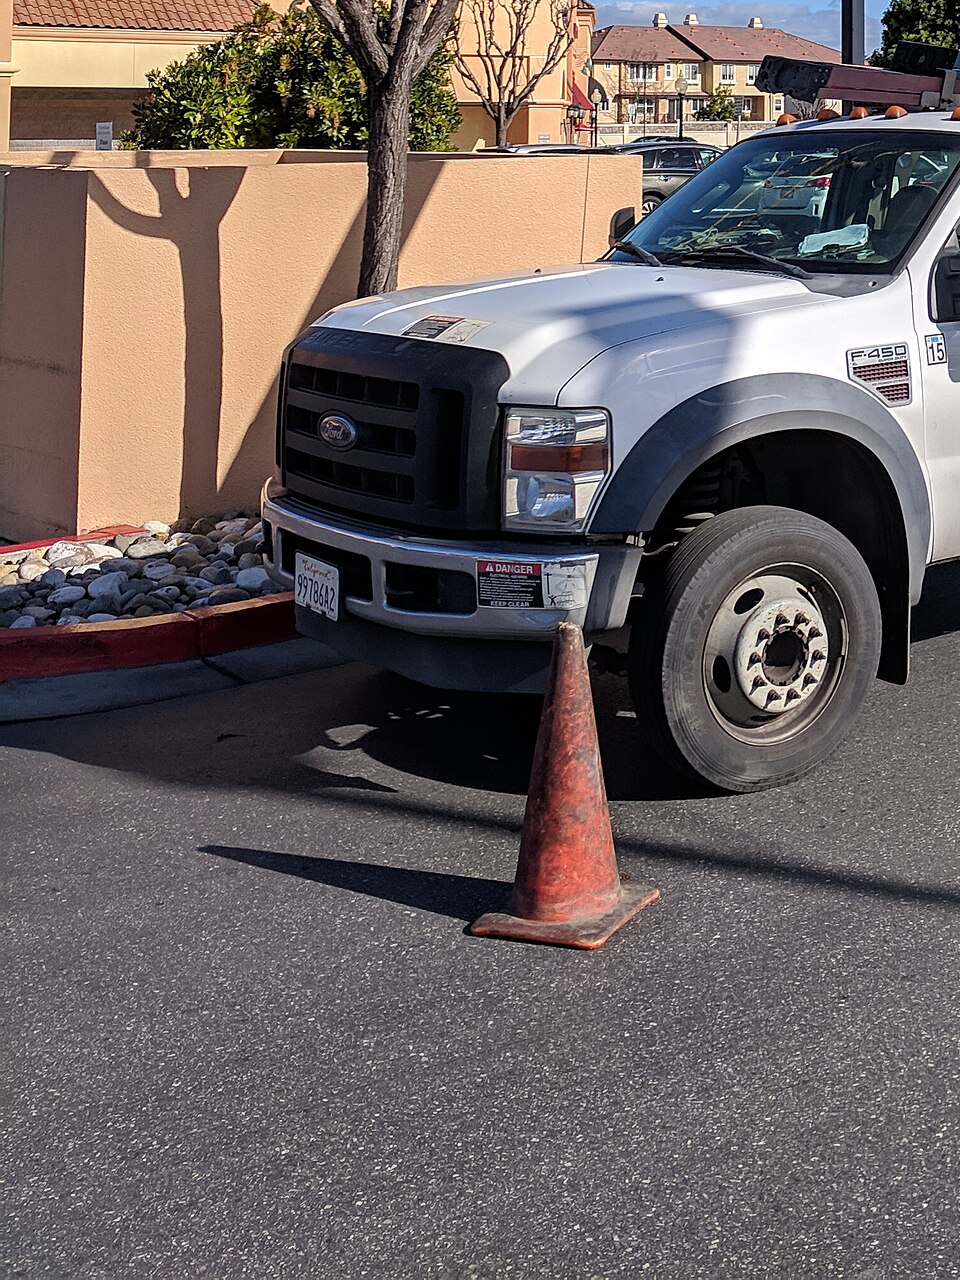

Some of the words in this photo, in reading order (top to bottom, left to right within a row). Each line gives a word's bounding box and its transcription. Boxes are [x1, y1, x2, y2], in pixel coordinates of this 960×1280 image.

[929, 343, 944, 362] 15
[495, 564, 533, 574] DANGER
[298, 574, 335, 612] 99786A2
